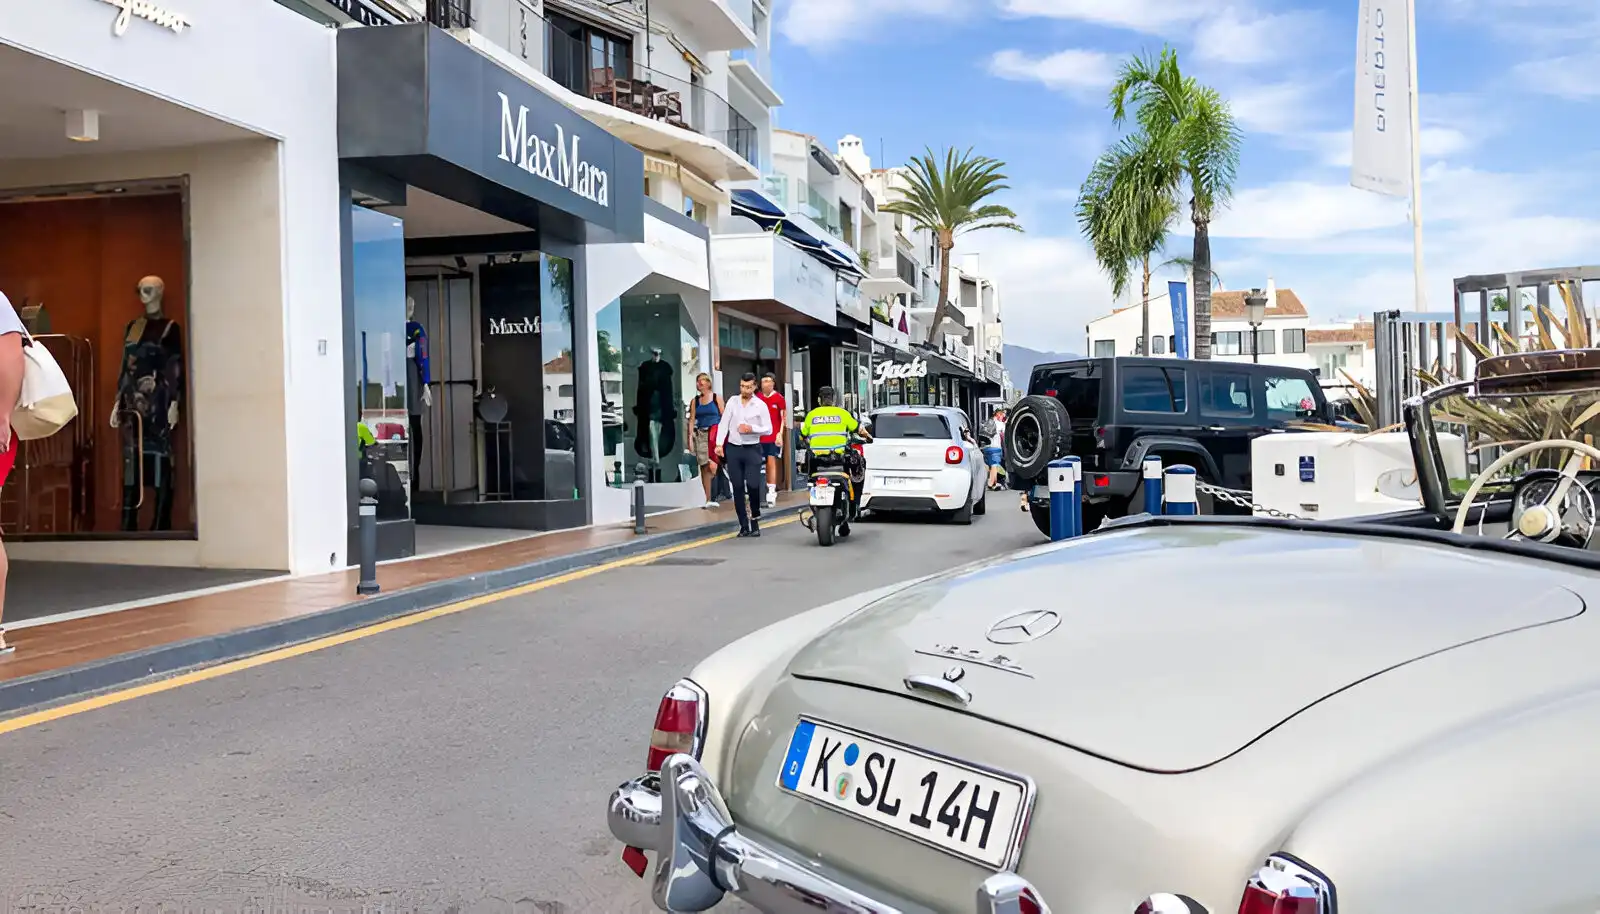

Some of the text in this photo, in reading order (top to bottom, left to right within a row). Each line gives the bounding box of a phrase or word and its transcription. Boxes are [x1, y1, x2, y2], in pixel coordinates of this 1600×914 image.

[497, 91, 608, 207] MaxMara
[811, 737, 1000, 849] K SL 14H
